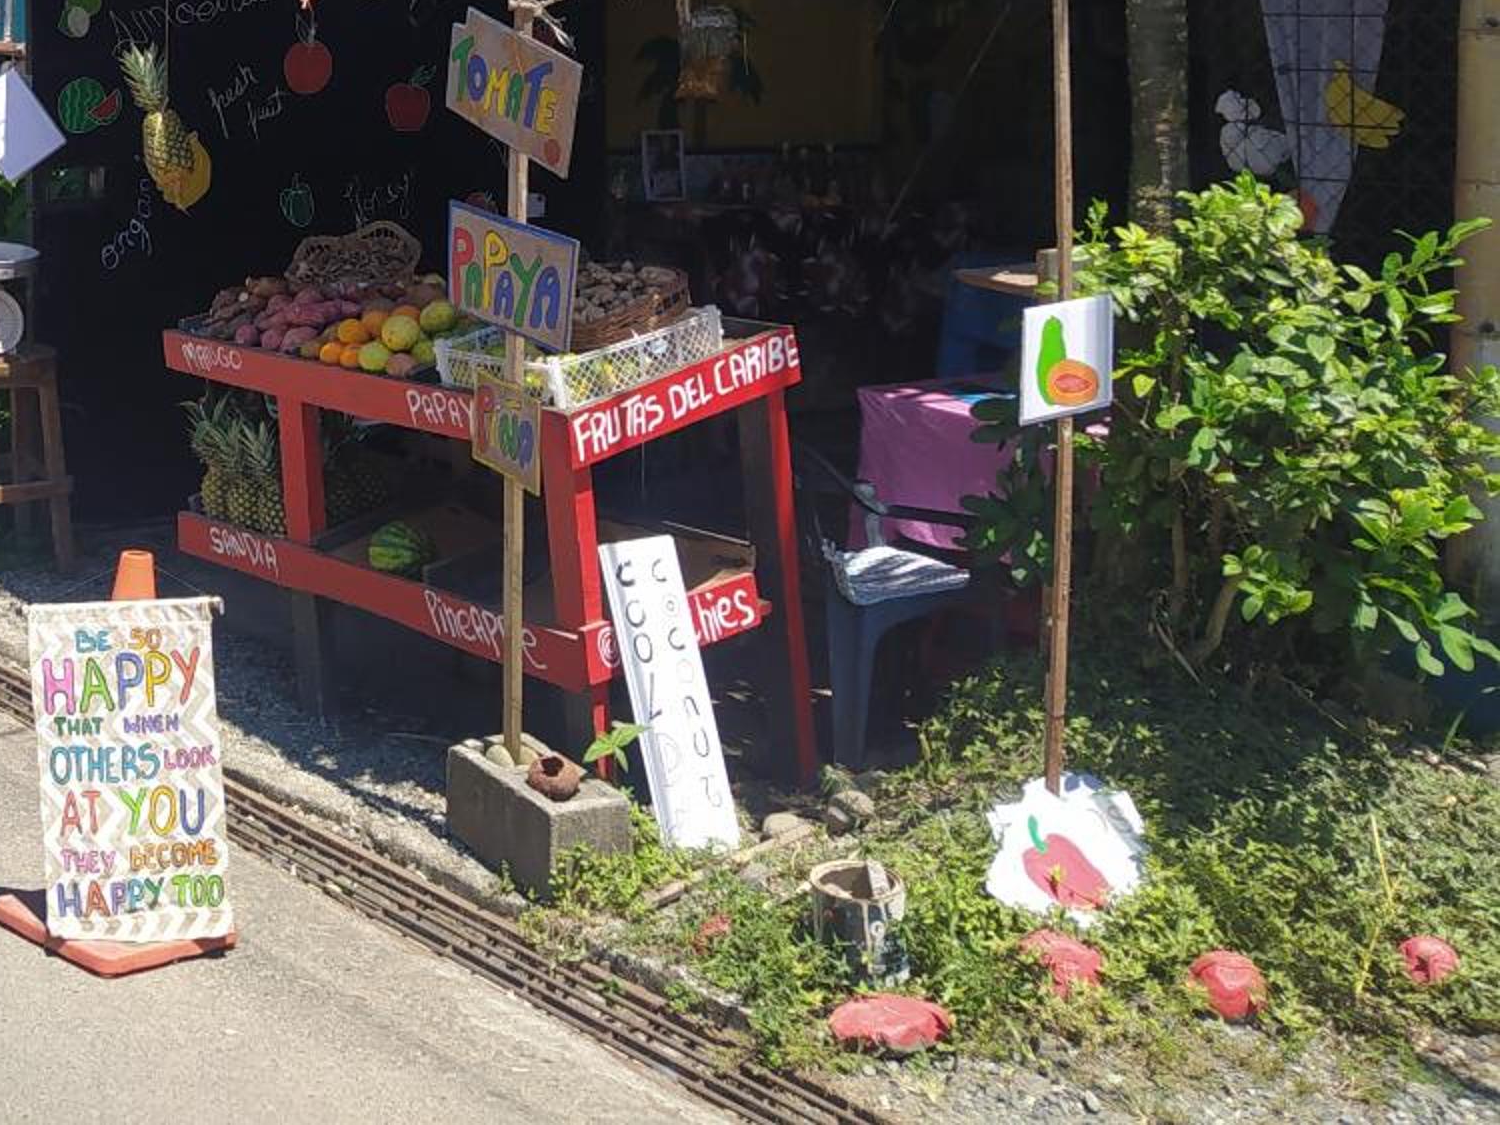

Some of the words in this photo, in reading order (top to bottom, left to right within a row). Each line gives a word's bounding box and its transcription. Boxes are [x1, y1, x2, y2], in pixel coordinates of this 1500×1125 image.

[452, 35, 556, 135] TOMATE
[454, 227, 561, 330] PAPAYA
[405, 390, 473, 428] PAPAY
[573, 395, 665, 462] FRUTAS
[668, 373, 714, 420] DEL
[714, 334, 800, 396] CARIBE
[74, 629, 111, 653] BE
[129, 628, 162, 652] SO
[41, 647, 200, 716] HAPPY
[53, 716, 104, 737] THAT
[123, 713, 180, 735] WHEN
[49, 741, 160, 786] OTHERS
[163, 745, 217, 770] LOOK
[60, 790, 100, 837] AT
[119, 785, 205, 835] YOU
[60, 848, 116, 874] THEY
[57, 877, 165, 918] HAPPY
[172, 875, 225, 908] TOO
